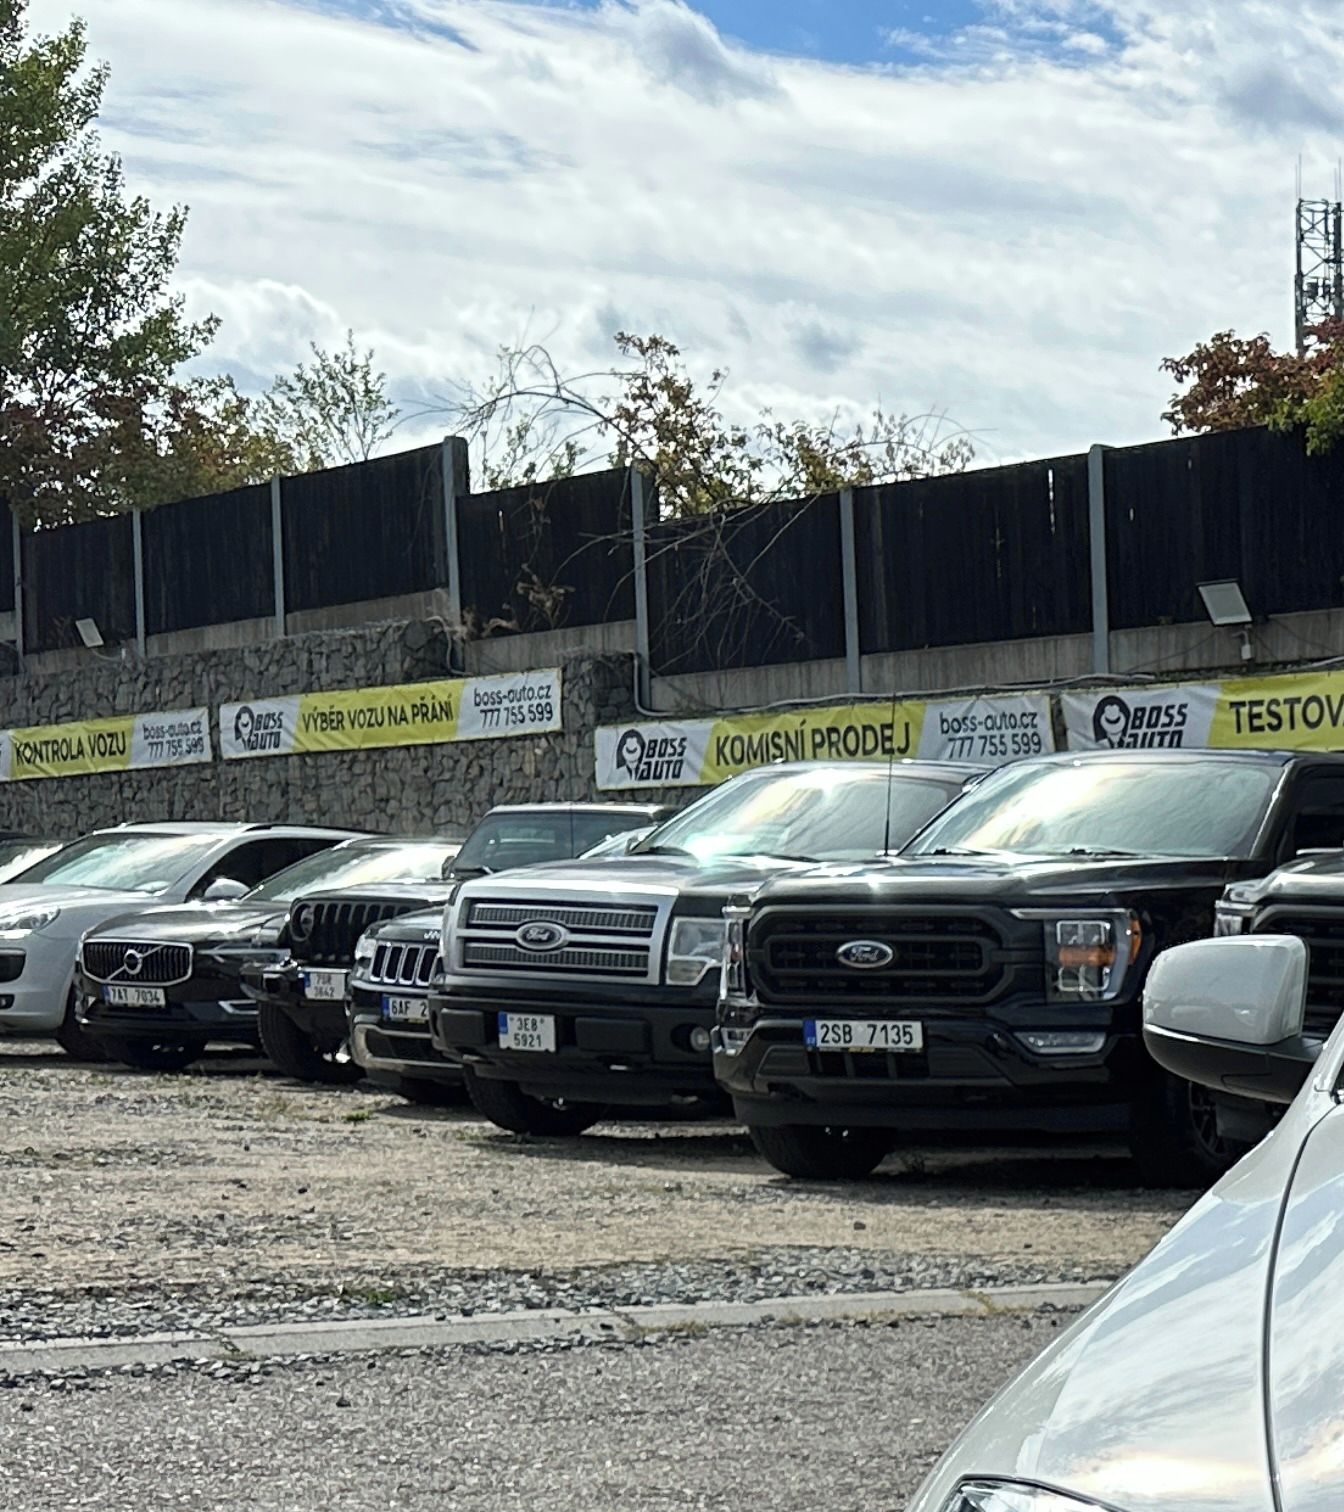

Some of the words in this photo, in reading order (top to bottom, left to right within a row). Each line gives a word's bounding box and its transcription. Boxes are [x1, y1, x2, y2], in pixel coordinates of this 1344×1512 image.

[474, 685, 552, 707] boss-auto.cz
[254, 712, 284, 731] BOSS
[347, 707, 384, 730] VOZU
[387, 706, 408, 727] NA
[411, 694, 454, 724] PŘÁNÍ
[480, 708, 501, 728] 777
[504, 706, 525, 725] 755
[528, 702, 553, 722] 599
[940, 711, 1038, 734] boss-auto.cz
[1131, 703, 1188, 730] BOSS
[143, 721, 202, 740] boss-auto.cz
[250, 731, 281, 750] AUTO
[15, 737, 85, 767] KONTROLA
[88, 731, 126, 759] VOZU
[645, 737, 687, 758] BOSS
[716, 719, 807, 767] KOMISNÍ
[812, 721, 910, 758] PRODEJ
[948, 737, 974, 759] 777
[980, 735, 1007, 757] 755
[1011, 732, 1042, 755] 599
[638, 759, 684, 781] AUTO
[391, 1000, 410, 1015] 6AF
[513, 1033, 542, 1047] 5921
[820, 1023, 853, 1045] 2SB
[867, 1024, 914, 1046] 7135
